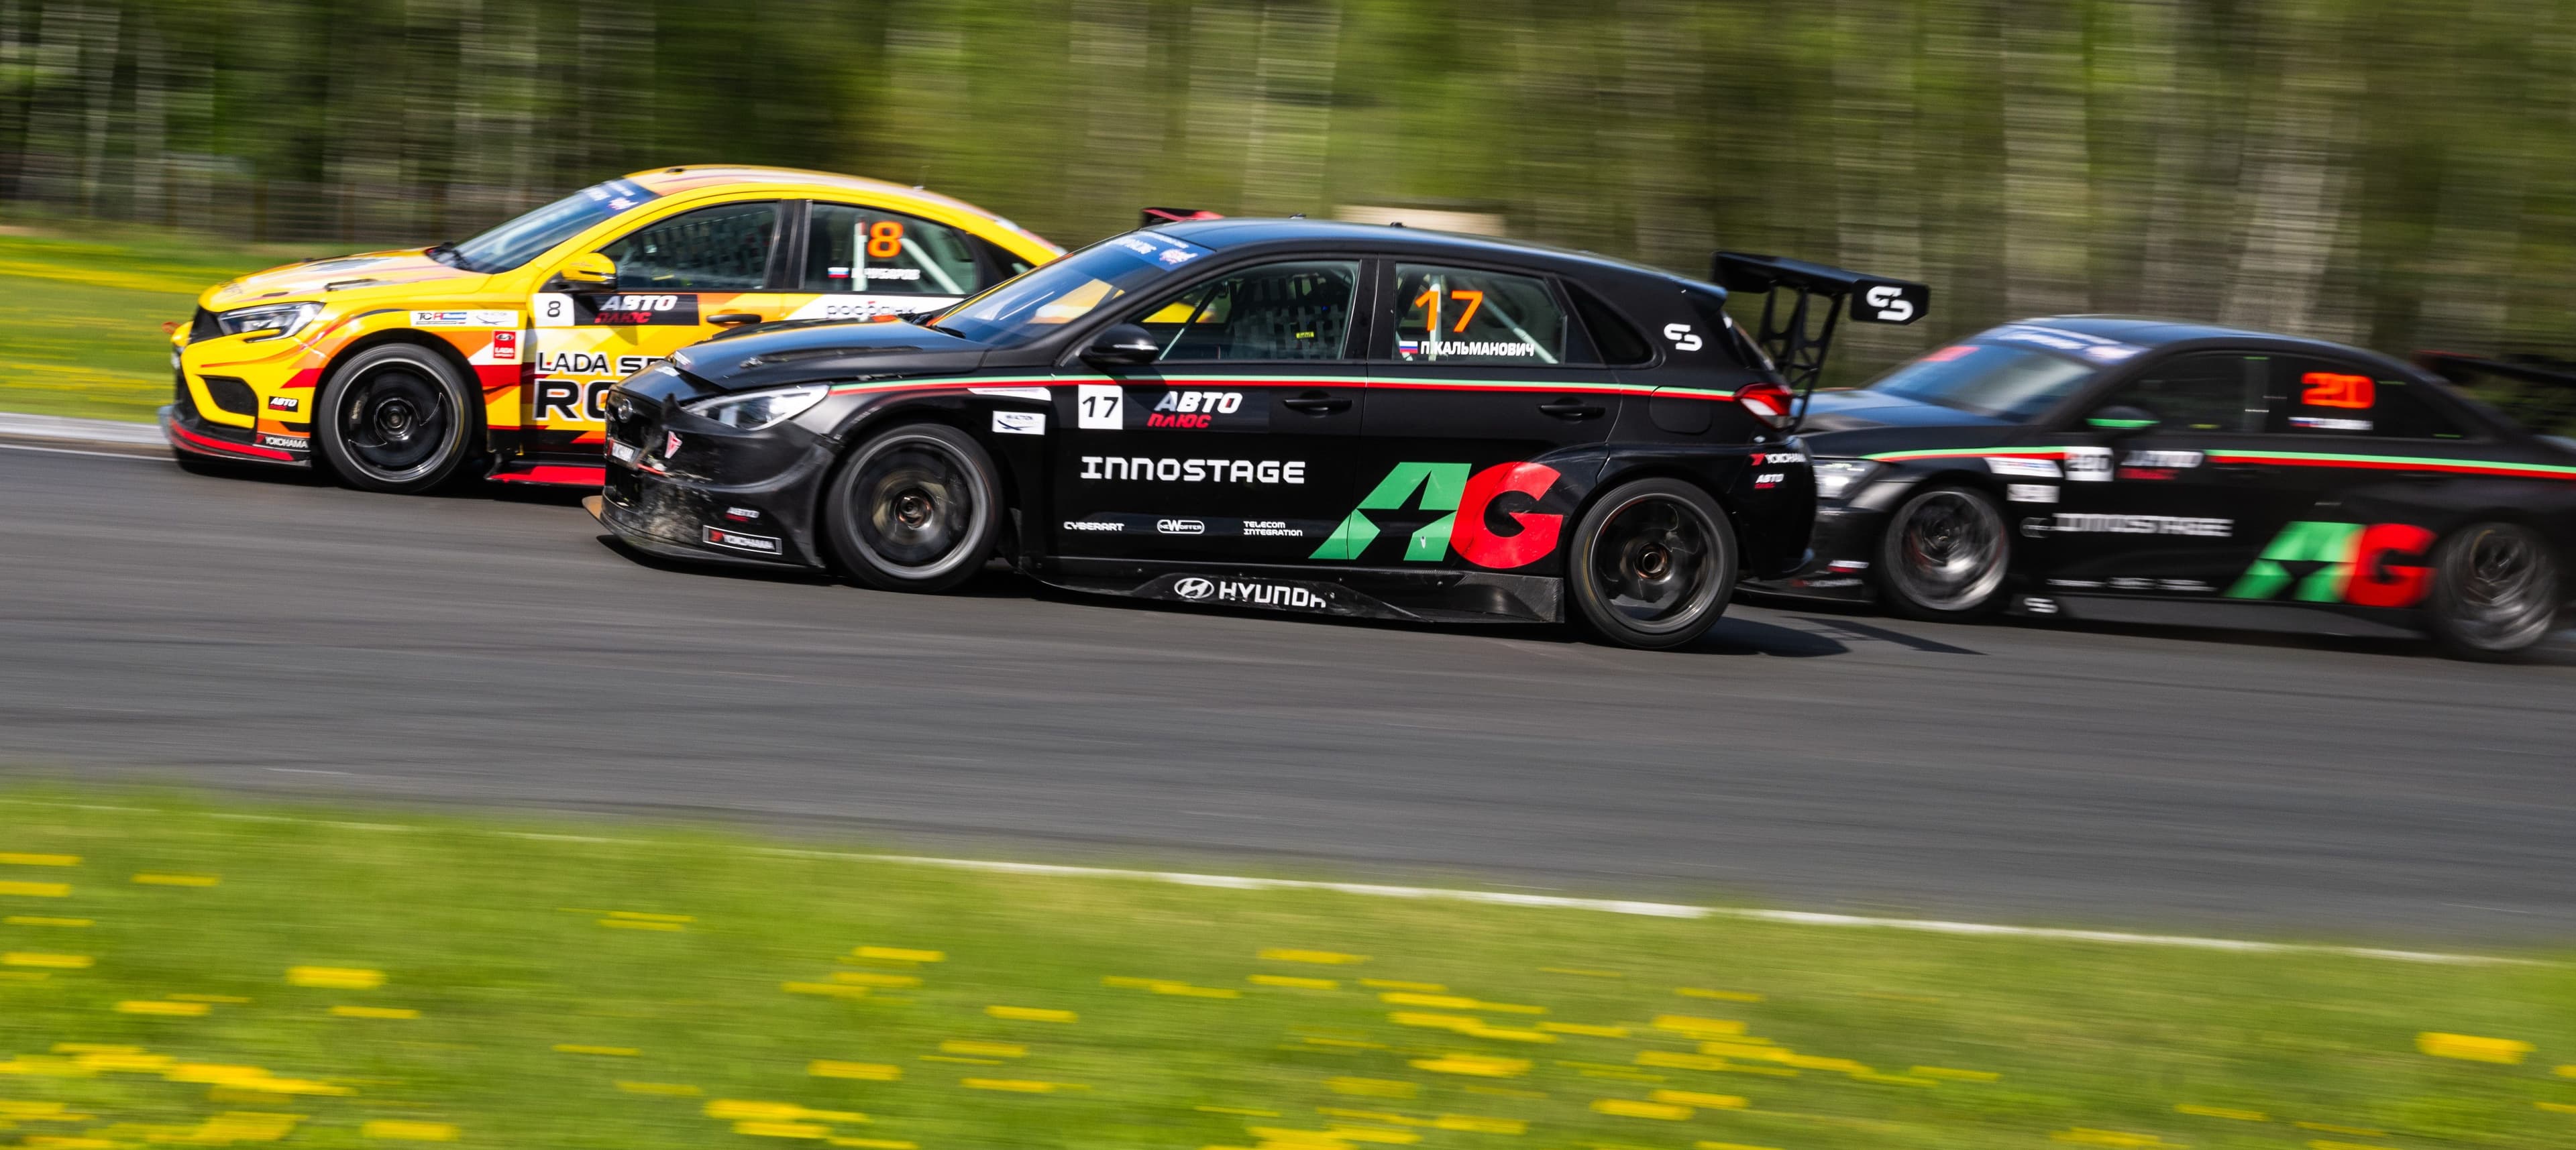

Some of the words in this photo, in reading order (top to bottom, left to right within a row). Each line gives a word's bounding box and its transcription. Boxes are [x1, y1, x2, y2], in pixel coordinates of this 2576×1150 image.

[867, 221, 904, 257] 8
[547, 301, 561, 317] 8
[600, 295, 678, 310] АВТО
[1415, 290, 1484, 333] 17
[594, 312, 652, 323] ПЛЮС
[538, 352, 609, 373] LADA
[1083, 396, 1119, 418] 17
[1154, 391, 1242, 414] АВТО
[1146, 412, 1212, 428] ПЛЮС
[1080, 456, 1305, 483] INNOSTAGE
[1063, 521, 1124, 531] CYBERART
[1243, 528, 1303, 536] INTEGRATION
[1219, 581, 1326, 608] HYUND
